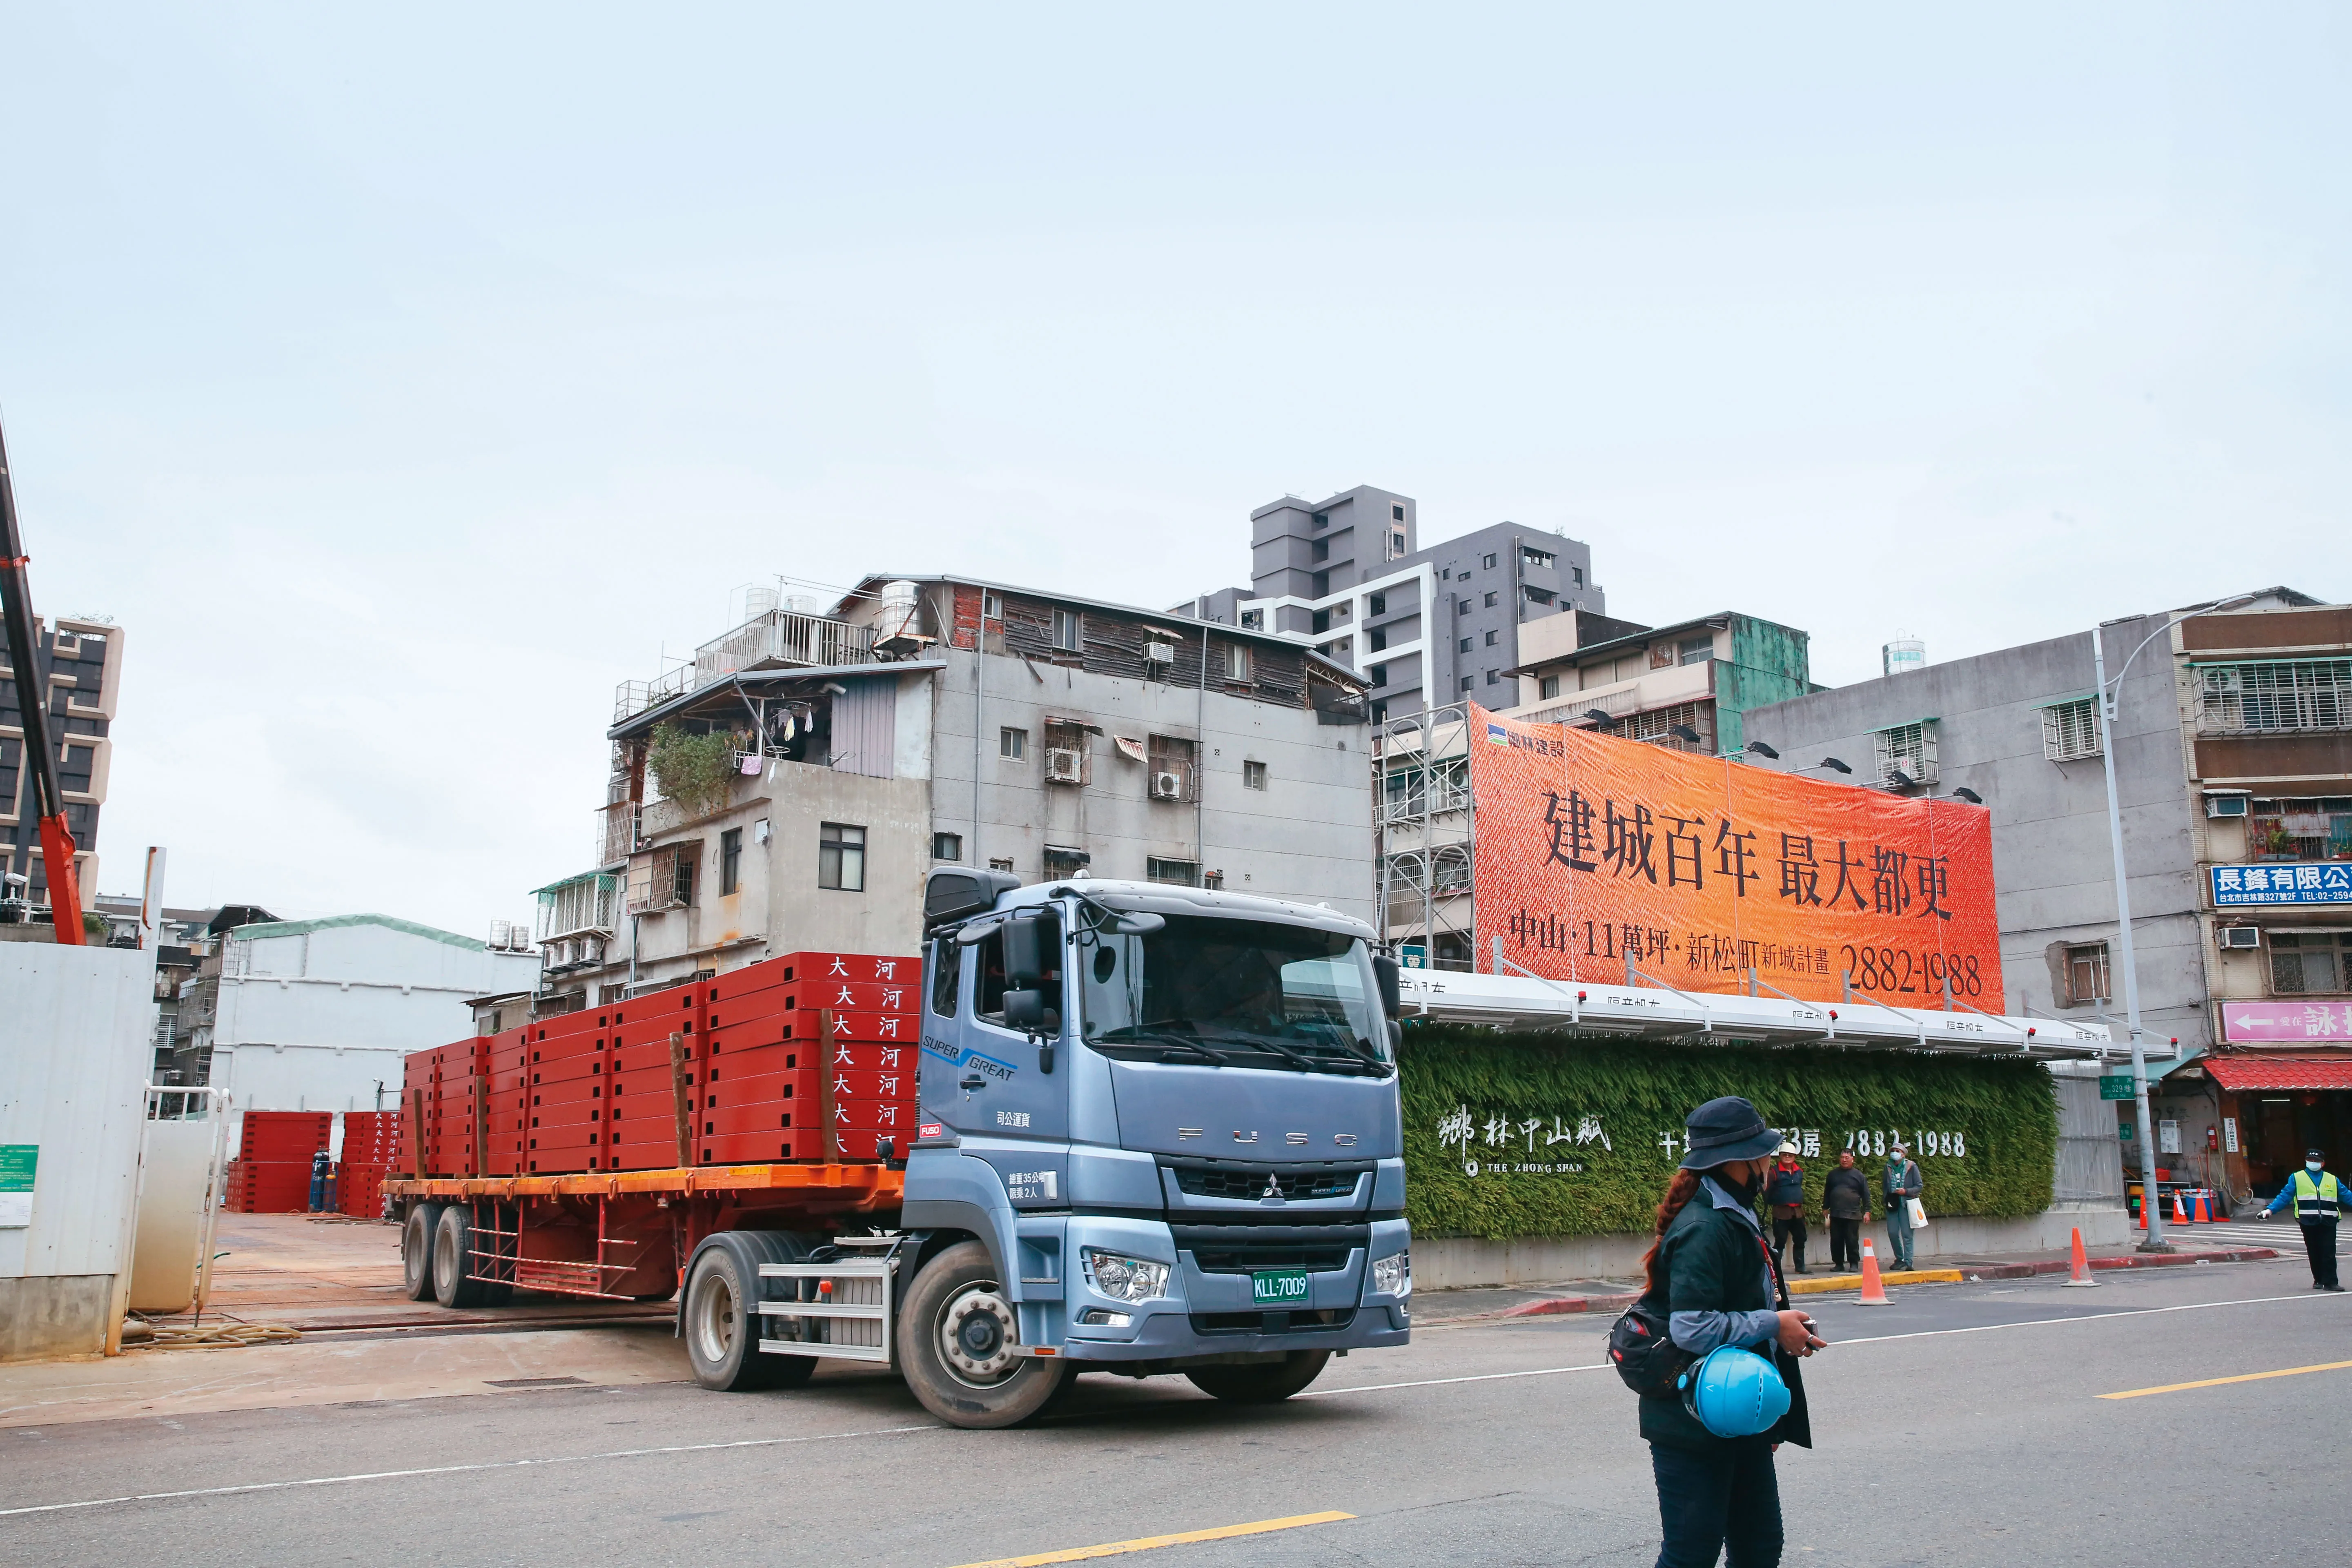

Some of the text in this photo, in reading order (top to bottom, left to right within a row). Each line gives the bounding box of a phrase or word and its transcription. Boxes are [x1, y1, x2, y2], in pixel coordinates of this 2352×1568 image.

[1541, 791, 1953, 921] 建城百年 最大都更
[2217, 866, 2352, 891] 長鋒有限公
[1840, 945, 1982, 996] 2882-1988
[923, 1036, 1015, 1080] SUPER GREAT
[922, 1126, 939, 1135] FUSO
[1178, 1128, 1357, 1146] FUSO
[1487, 1163, 1582, 1173] THE ZHONG SHAN
